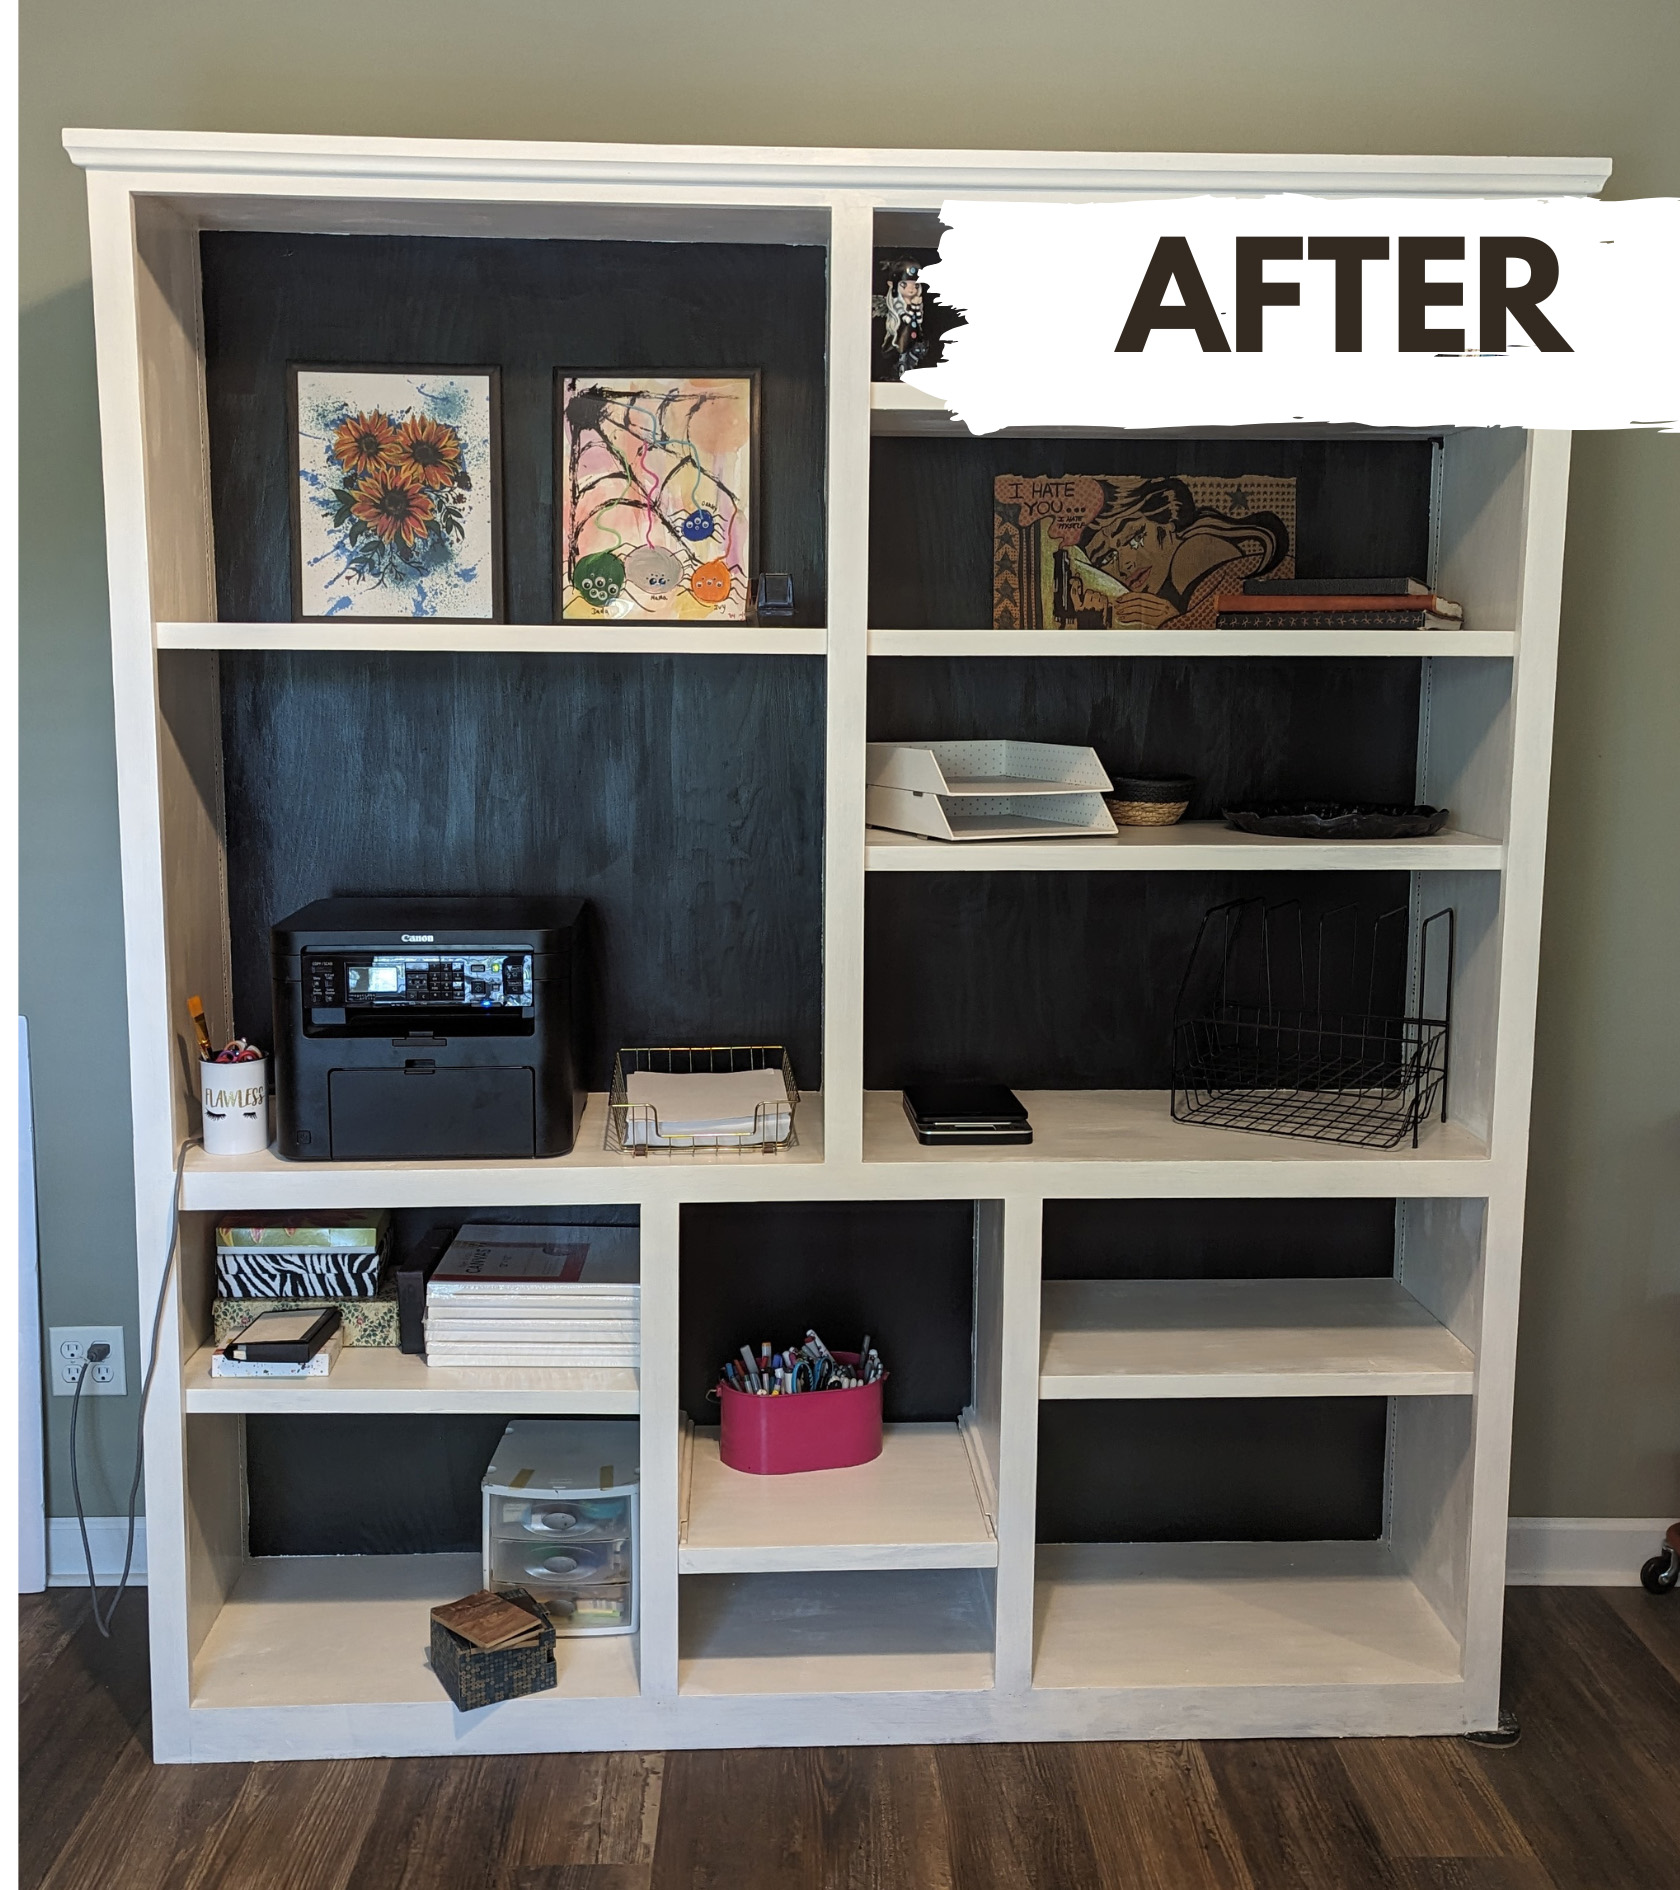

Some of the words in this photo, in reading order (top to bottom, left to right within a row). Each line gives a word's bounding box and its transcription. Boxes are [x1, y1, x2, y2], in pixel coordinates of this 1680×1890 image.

[1009, 483, 1024, 499] I
[1032, 481, 1075, 499] HATE
[401, 934, 434, 943] Canon
[206, 1086, 265, 1108] FLAWLESS
